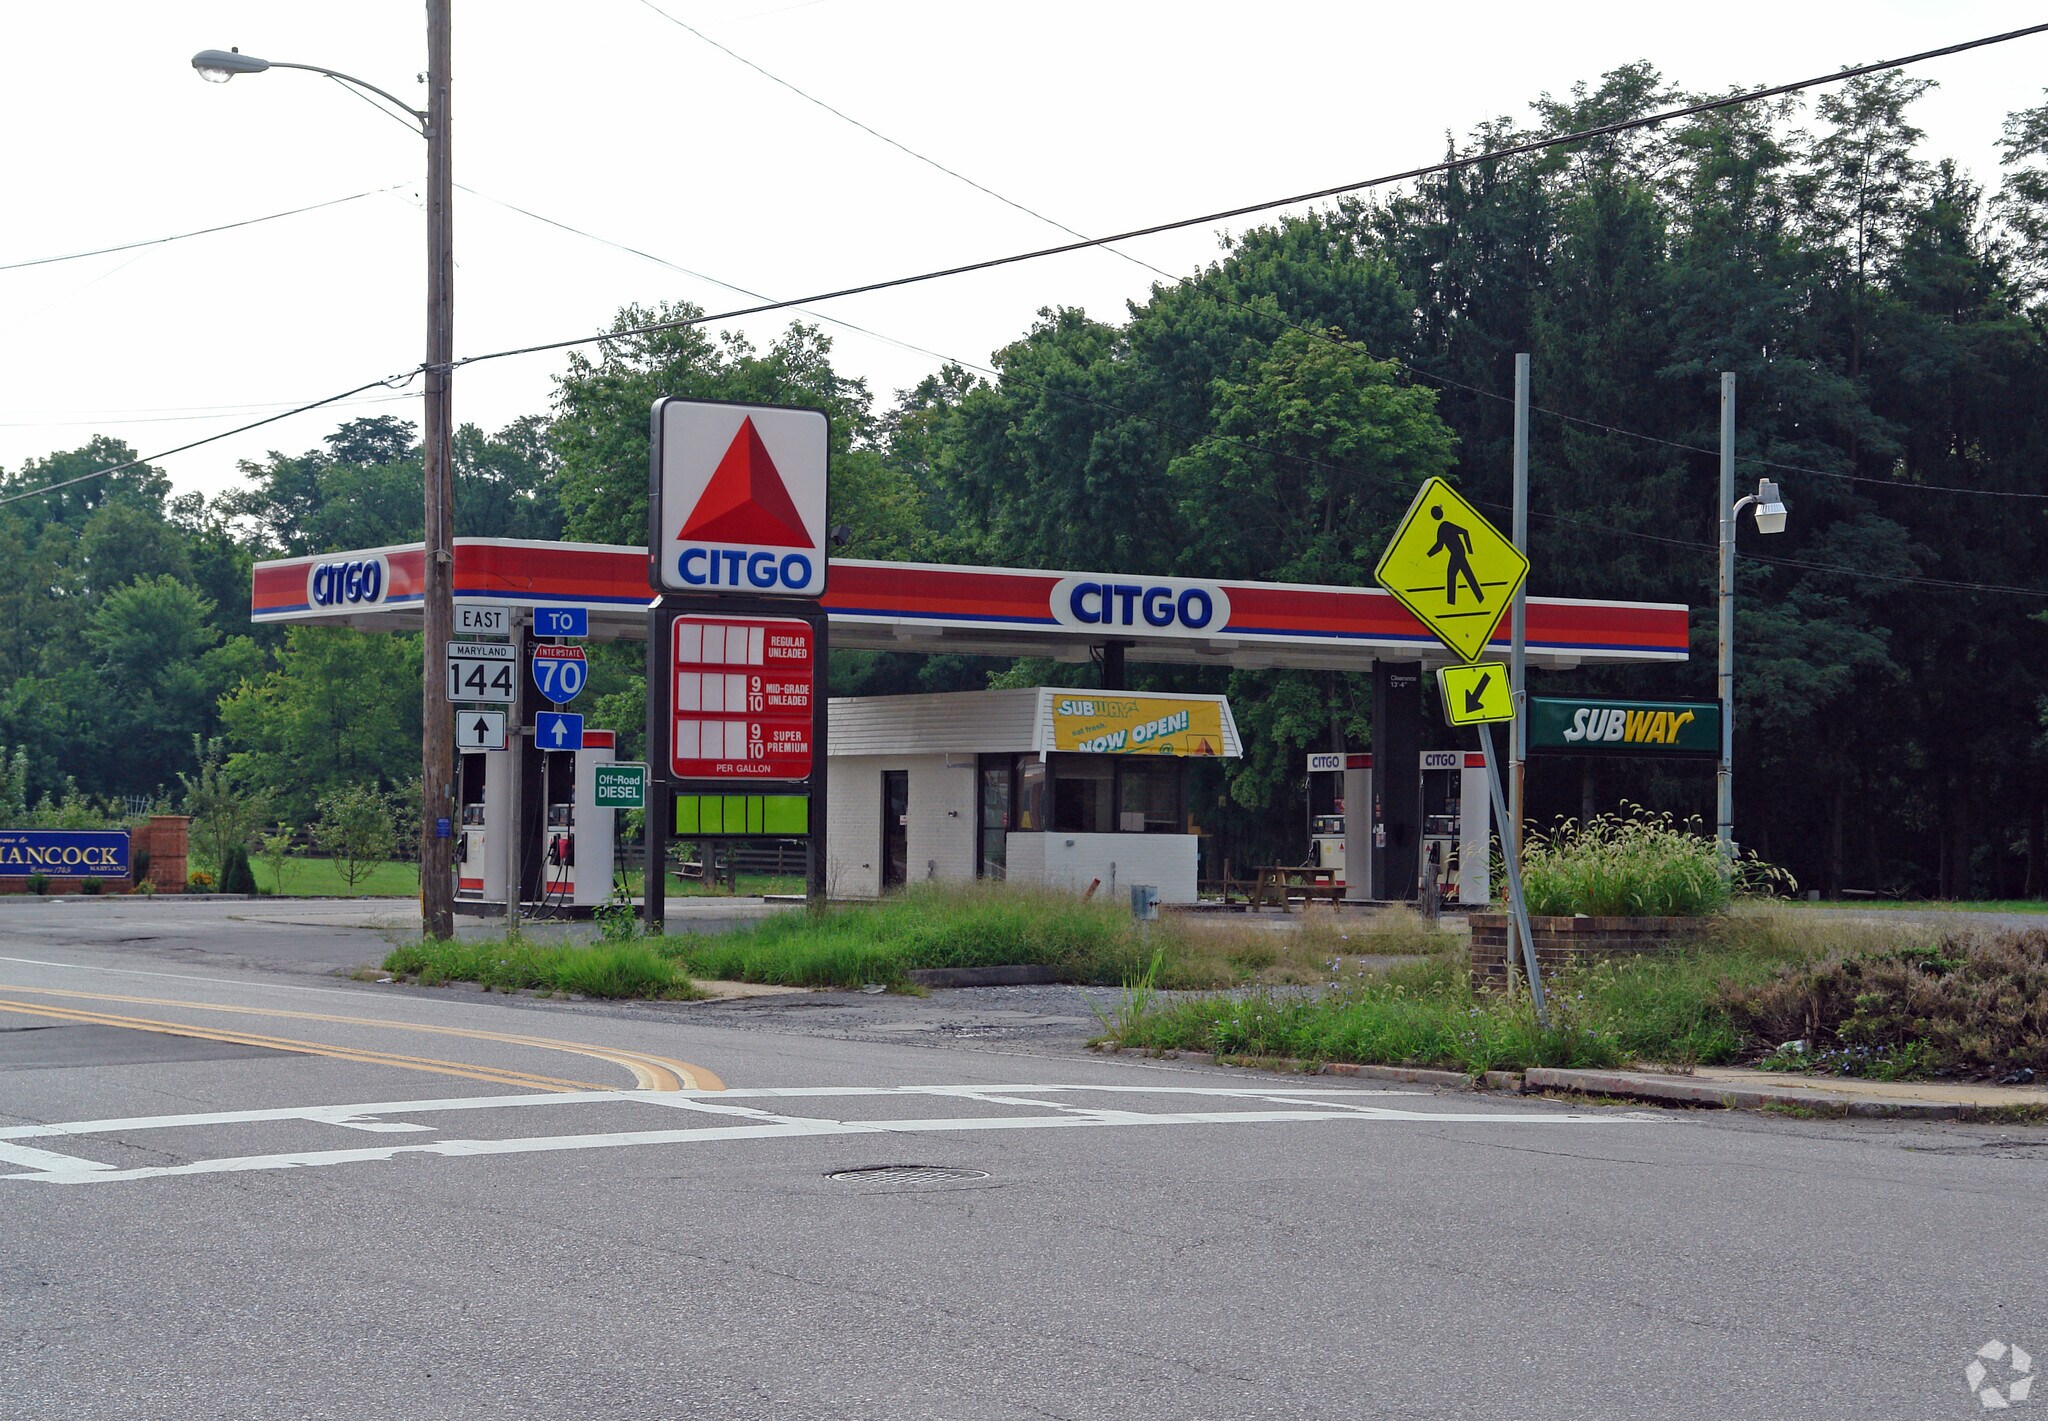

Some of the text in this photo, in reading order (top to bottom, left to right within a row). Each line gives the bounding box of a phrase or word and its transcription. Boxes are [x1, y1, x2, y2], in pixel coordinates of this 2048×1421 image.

[678, 548, 812, 589] CITGO
[313, 559, 382, 607] CITGO
[1070, 582, 1213, 629] CITGO
[463, 611, 501, 628] EAST
[548, 613, 573, 630] TO
[771, 636, 805, 647] REGULAR
[457, 646, 507, 656] MARYLAND
[539, 648, 581, 657] INTERSTATE
[768, 648, 807, 658] UNLEADED
[451, 663, 512, 696] 144
[537, 661, 581, 694] 70
[751, 676, 761, 692] 9
[1390, 674, 1417, 682] Clearance
[766, 684, 810, 695] MID-GRADE
[749, 695, 763, 712] 10
[768, 695, 807, 706] UNLEADED
[1056, 700, 1139, 718] SUBWAY
[751, 723, 761, 740] 9
[1072, 728, 1084, 736] eat
[1078, 710, 1189, 753] NOW OPEN!
[1563, 708, 1695, 744] SUBWAY
[773, 731, 802, 741] SUPER
[749, 742, 764, 759] 10
[767, 742, 808, 753] PREMIUM
[1312, 756, 1340, 769] CITGO
[1425, 753, 1456, 767] CITGO
[716, 764, 771, 773] PER GALLON
[599, 775, 640, 785] Off-Road
[599, 786, 640, 798] DIESEL
